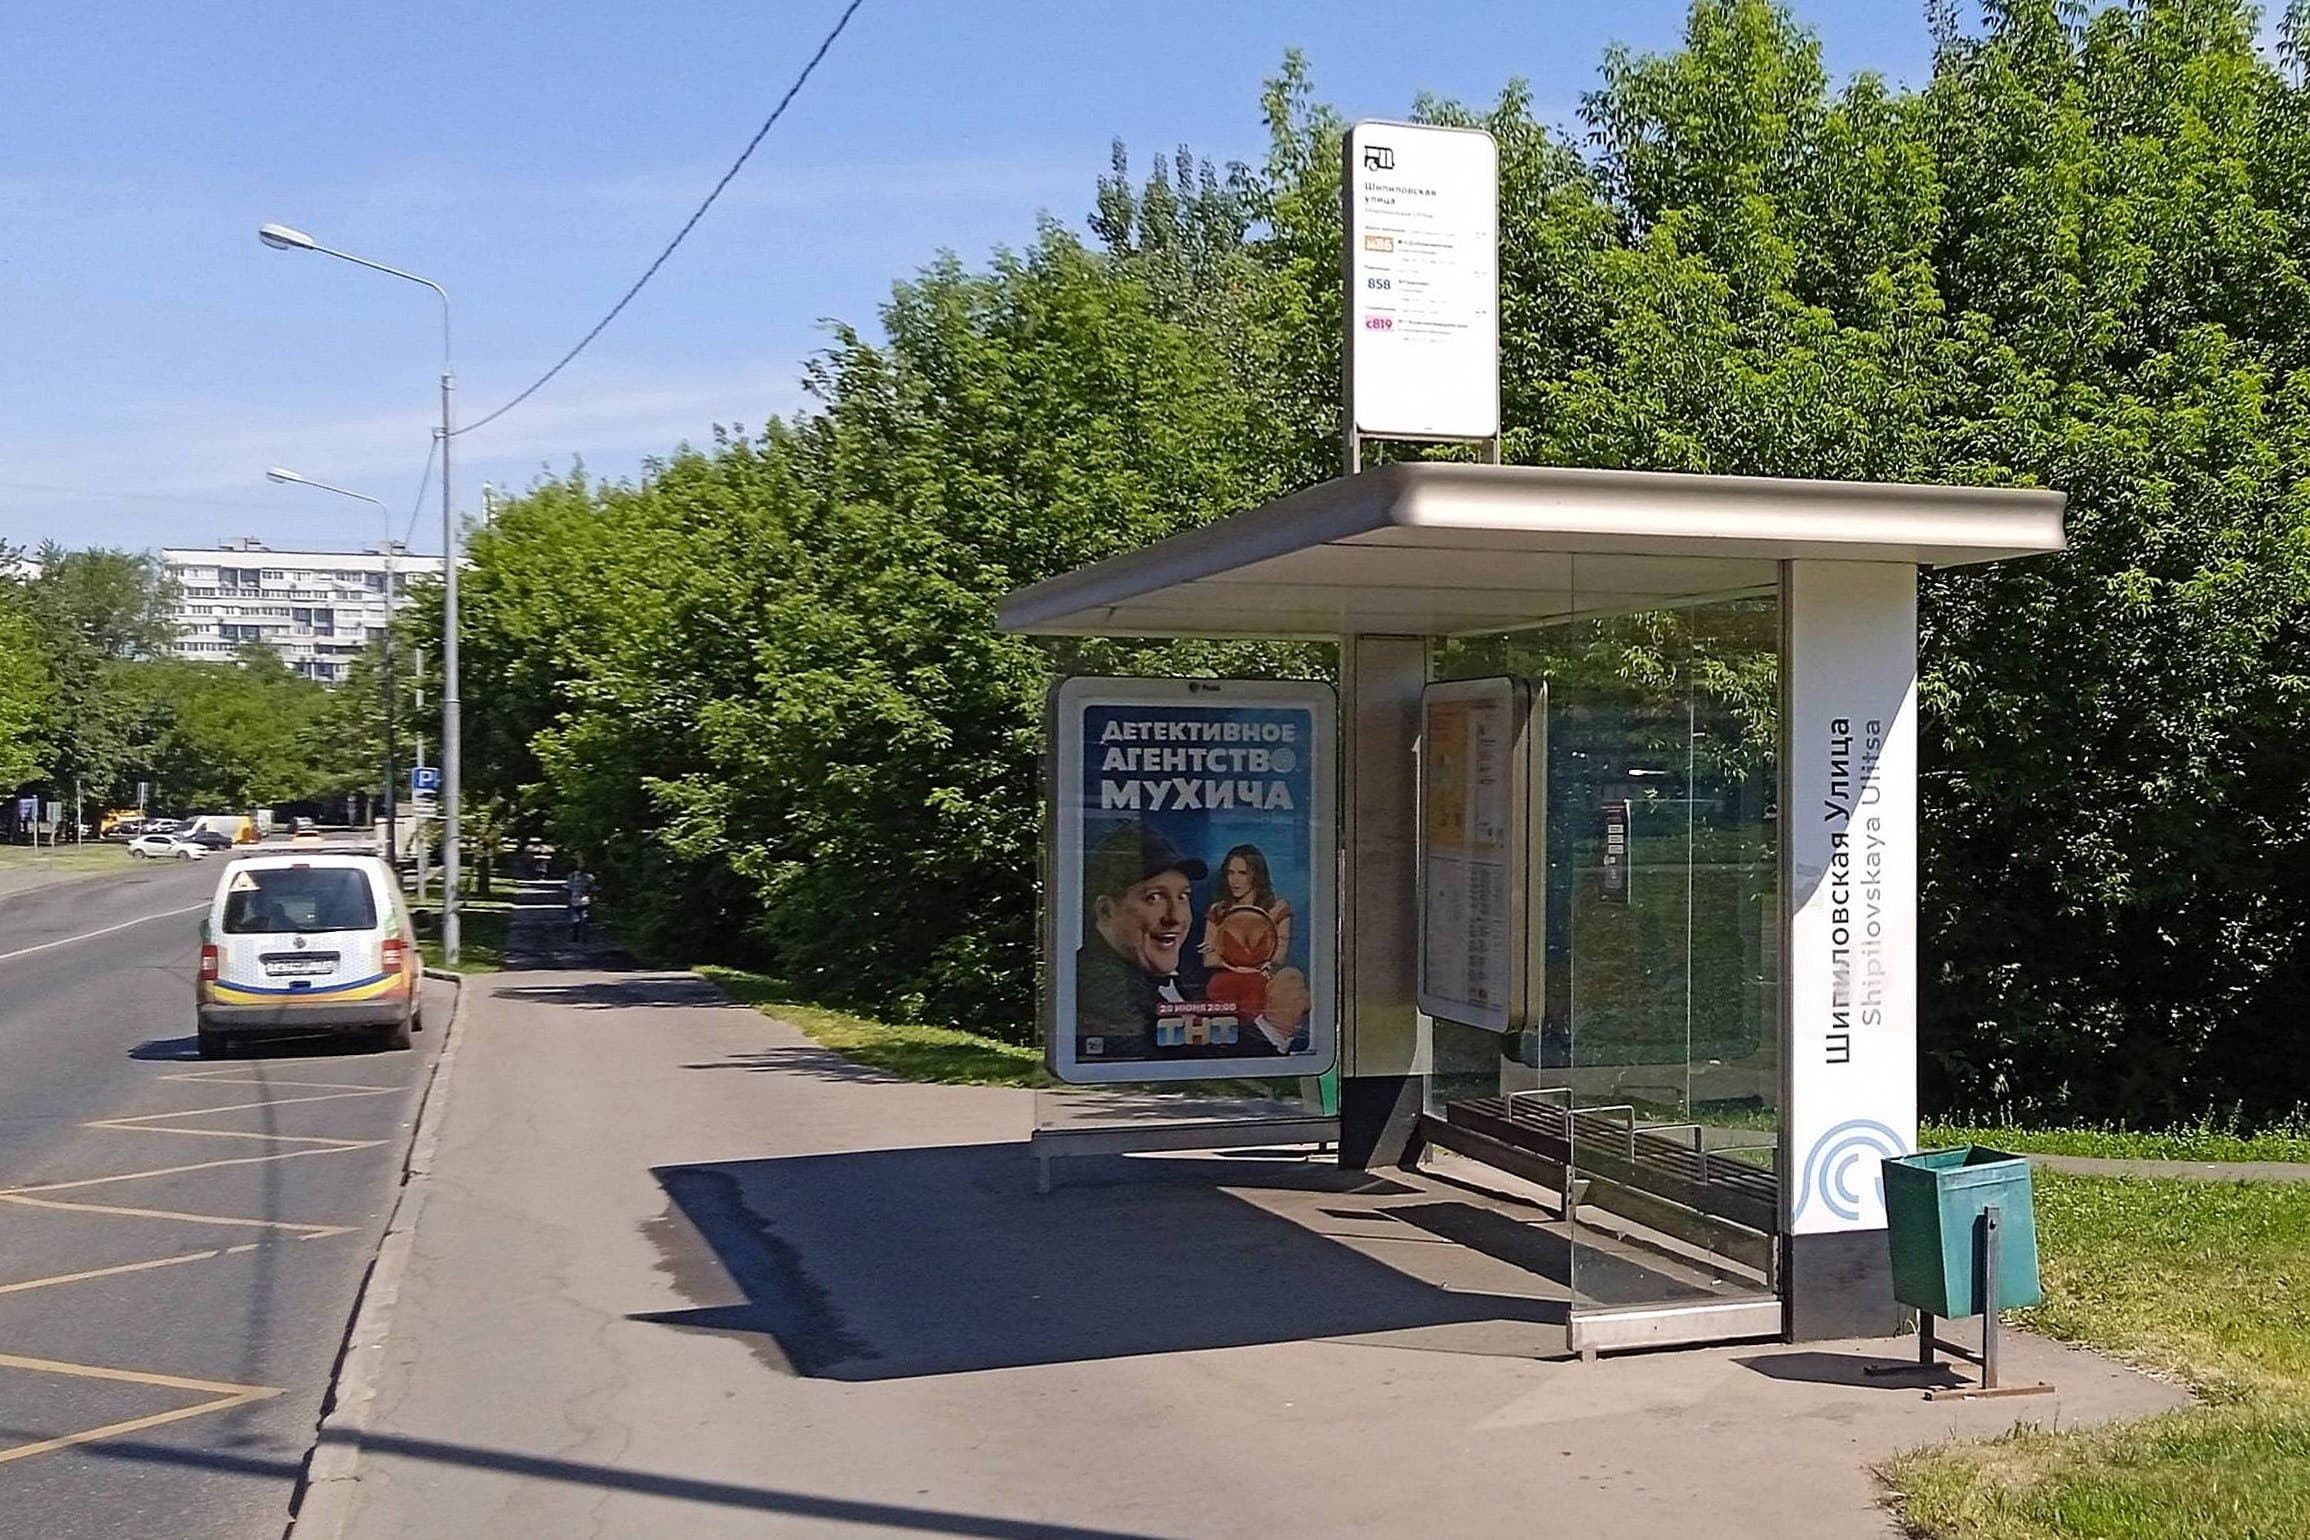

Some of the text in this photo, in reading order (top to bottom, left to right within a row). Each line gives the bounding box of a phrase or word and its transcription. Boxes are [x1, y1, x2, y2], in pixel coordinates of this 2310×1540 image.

[1364, 182, 1436, 196] Шипиловская
[1367, 278, 1391, 290] 858
[1102, 721, 1296, 742] ДЕТЕКТИВНОЕ
[1102, 748, 1297, 773] АГЕНТСТВО
[419, 770, 433, 787] P
[1101, 778, 1294, 811] МУХИЧА
[1860, 719, 1886, 1026] Shipilovskaya Ulitsa
[1825, 718, 1853, 1064] Шипиловская Улица
[1157, 1016, 1239, 1046] ТНТ
